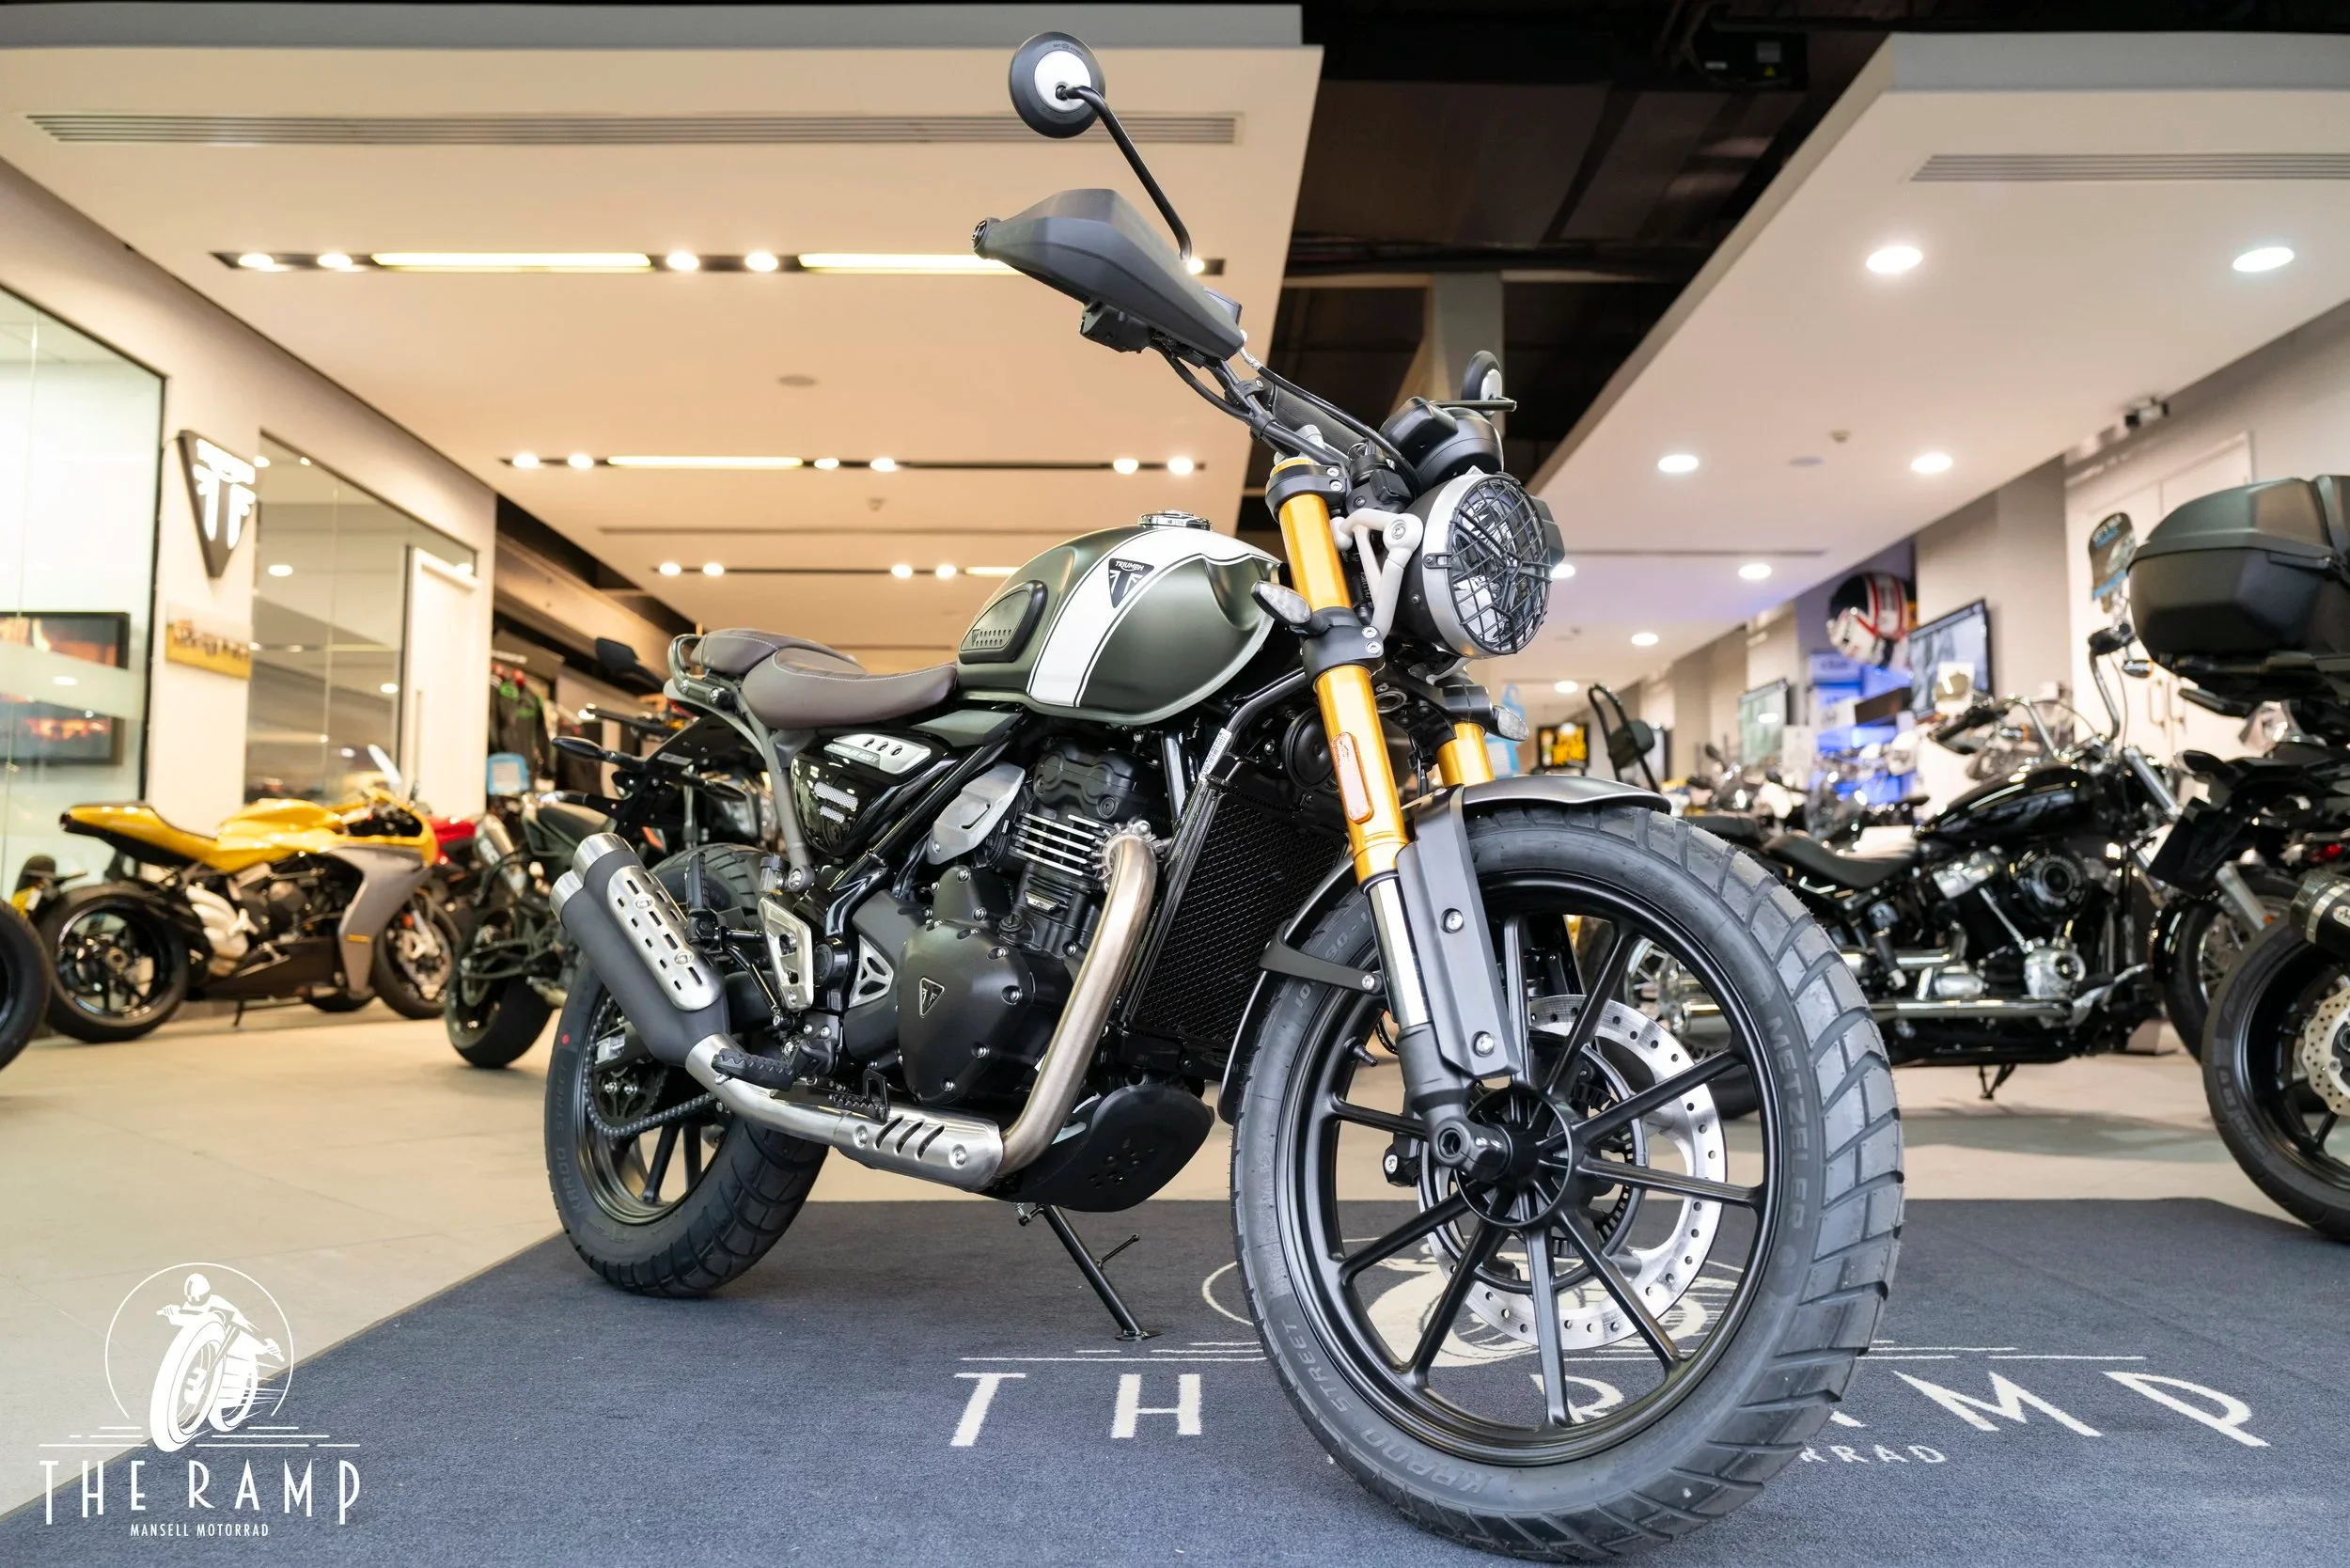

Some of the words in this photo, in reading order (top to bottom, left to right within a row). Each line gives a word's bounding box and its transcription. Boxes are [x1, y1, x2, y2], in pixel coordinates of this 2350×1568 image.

[1115, 560, 1145, 572] TRIUMPH
[1765, 1015, 1808, 1229] METZELER
[556, 1147, 583, 1214] KAROO
[1281, 1320, 1355, 1413] STREET
[949, 1372, 1202, 1448] TH
[1362, 1429, 1490, 1495] KAROO
